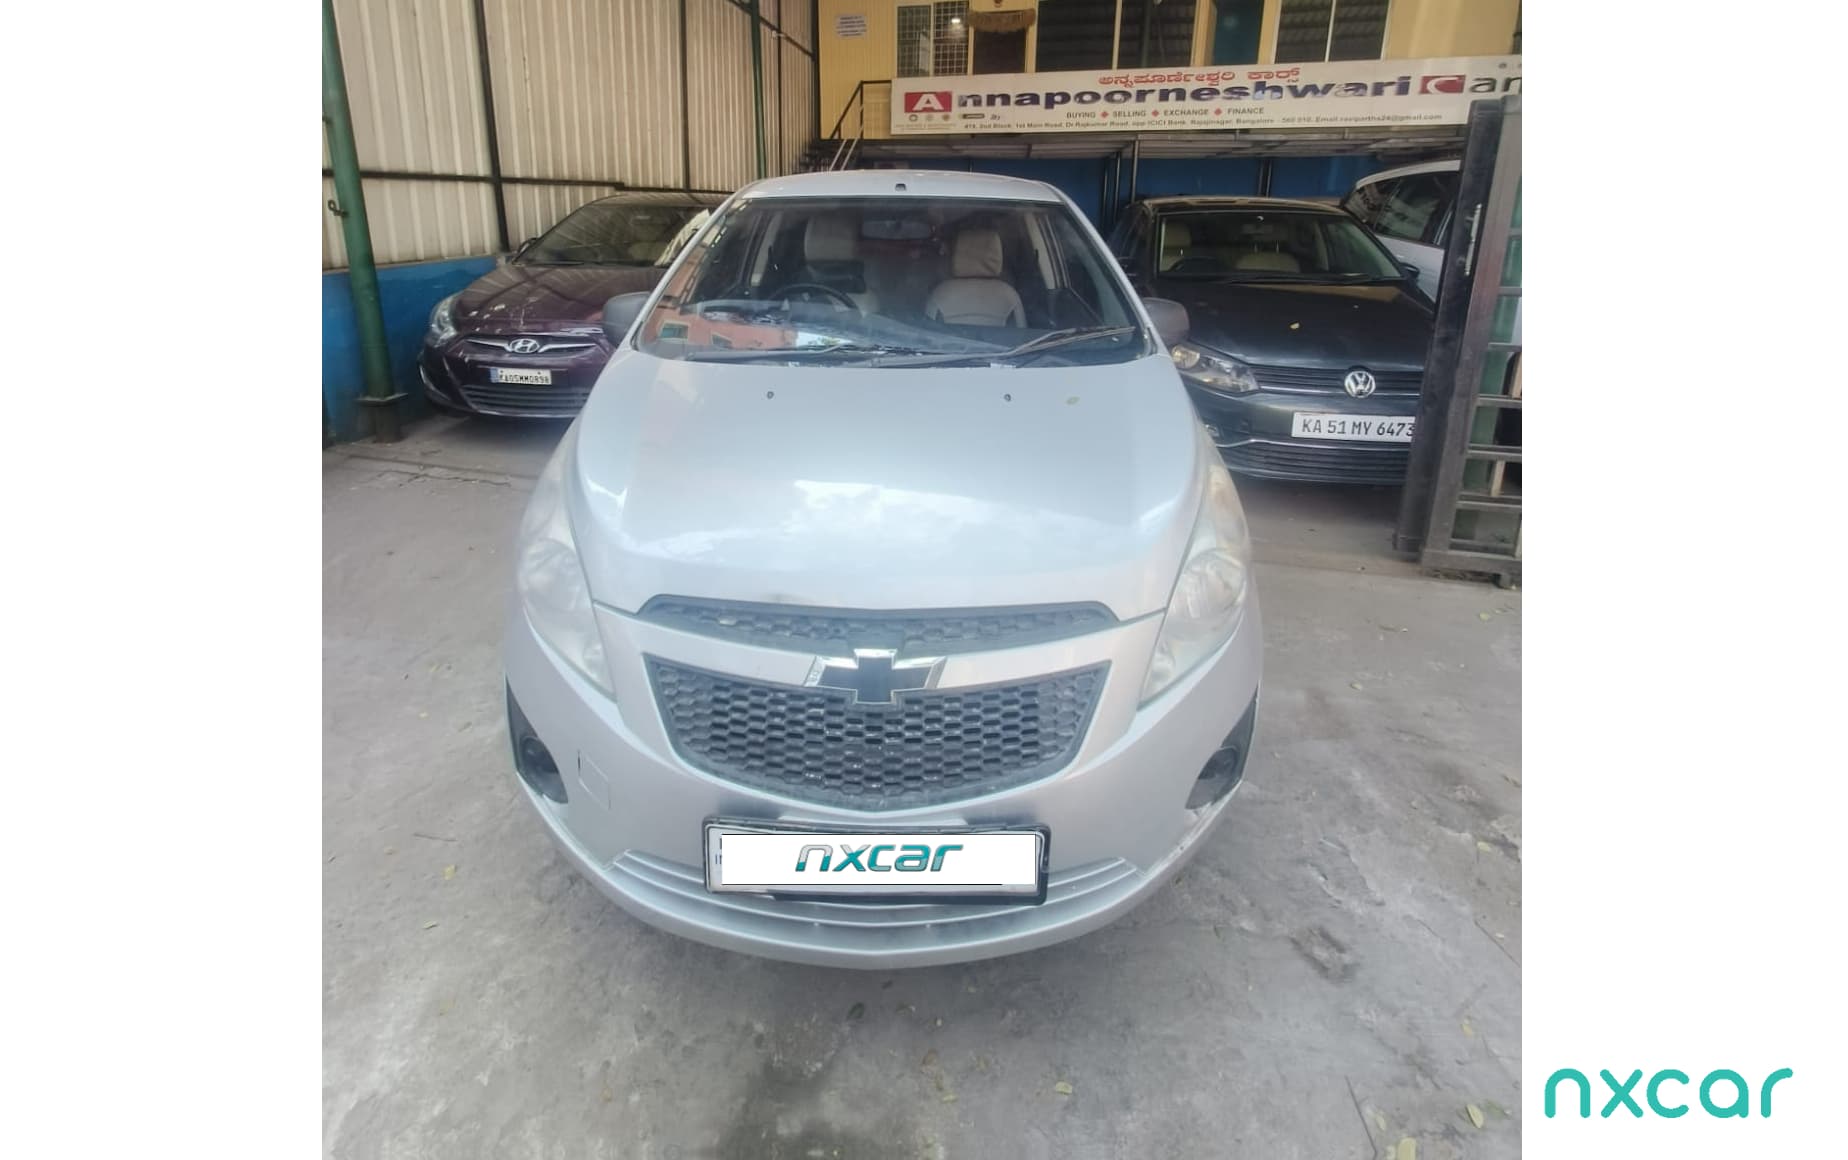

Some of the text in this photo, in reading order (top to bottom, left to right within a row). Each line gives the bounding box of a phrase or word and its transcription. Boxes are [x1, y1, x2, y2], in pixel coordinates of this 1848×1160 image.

[1164, 109, 1209, 117] EXCHANGE
[1227, 107, 1264, 115] FINANCE
[1301, 419, 1322, 433] KA
[1327, 420, 1346, 434] 51
[1351, 421, 1372, 435] MY
